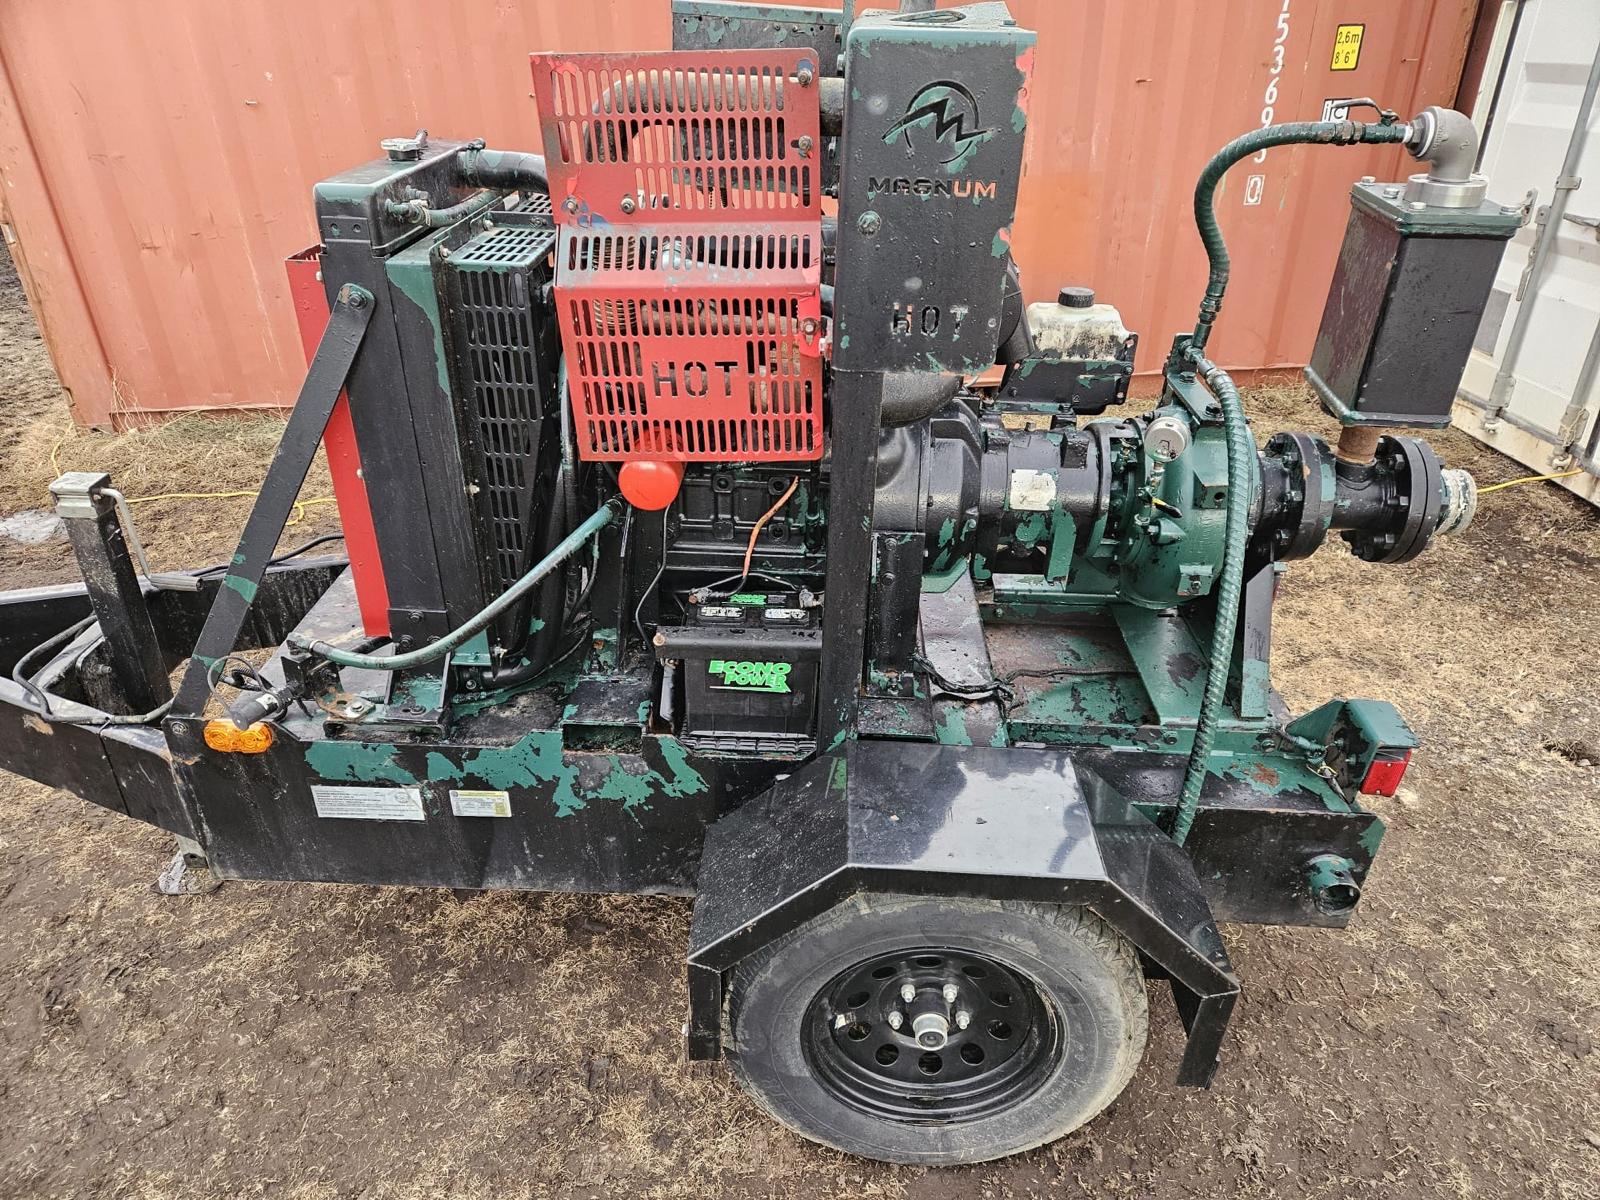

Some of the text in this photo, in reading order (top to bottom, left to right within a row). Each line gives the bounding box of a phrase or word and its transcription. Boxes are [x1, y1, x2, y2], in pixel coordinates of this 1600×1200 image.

[868, 177, 997, 199] MAGNUM
[891, 302, 969, 338] HOT
[652, 361, 739, 397] HOT
[709, 660, 792, 675] ECONO
[724, 672, 788, 689] POWER
